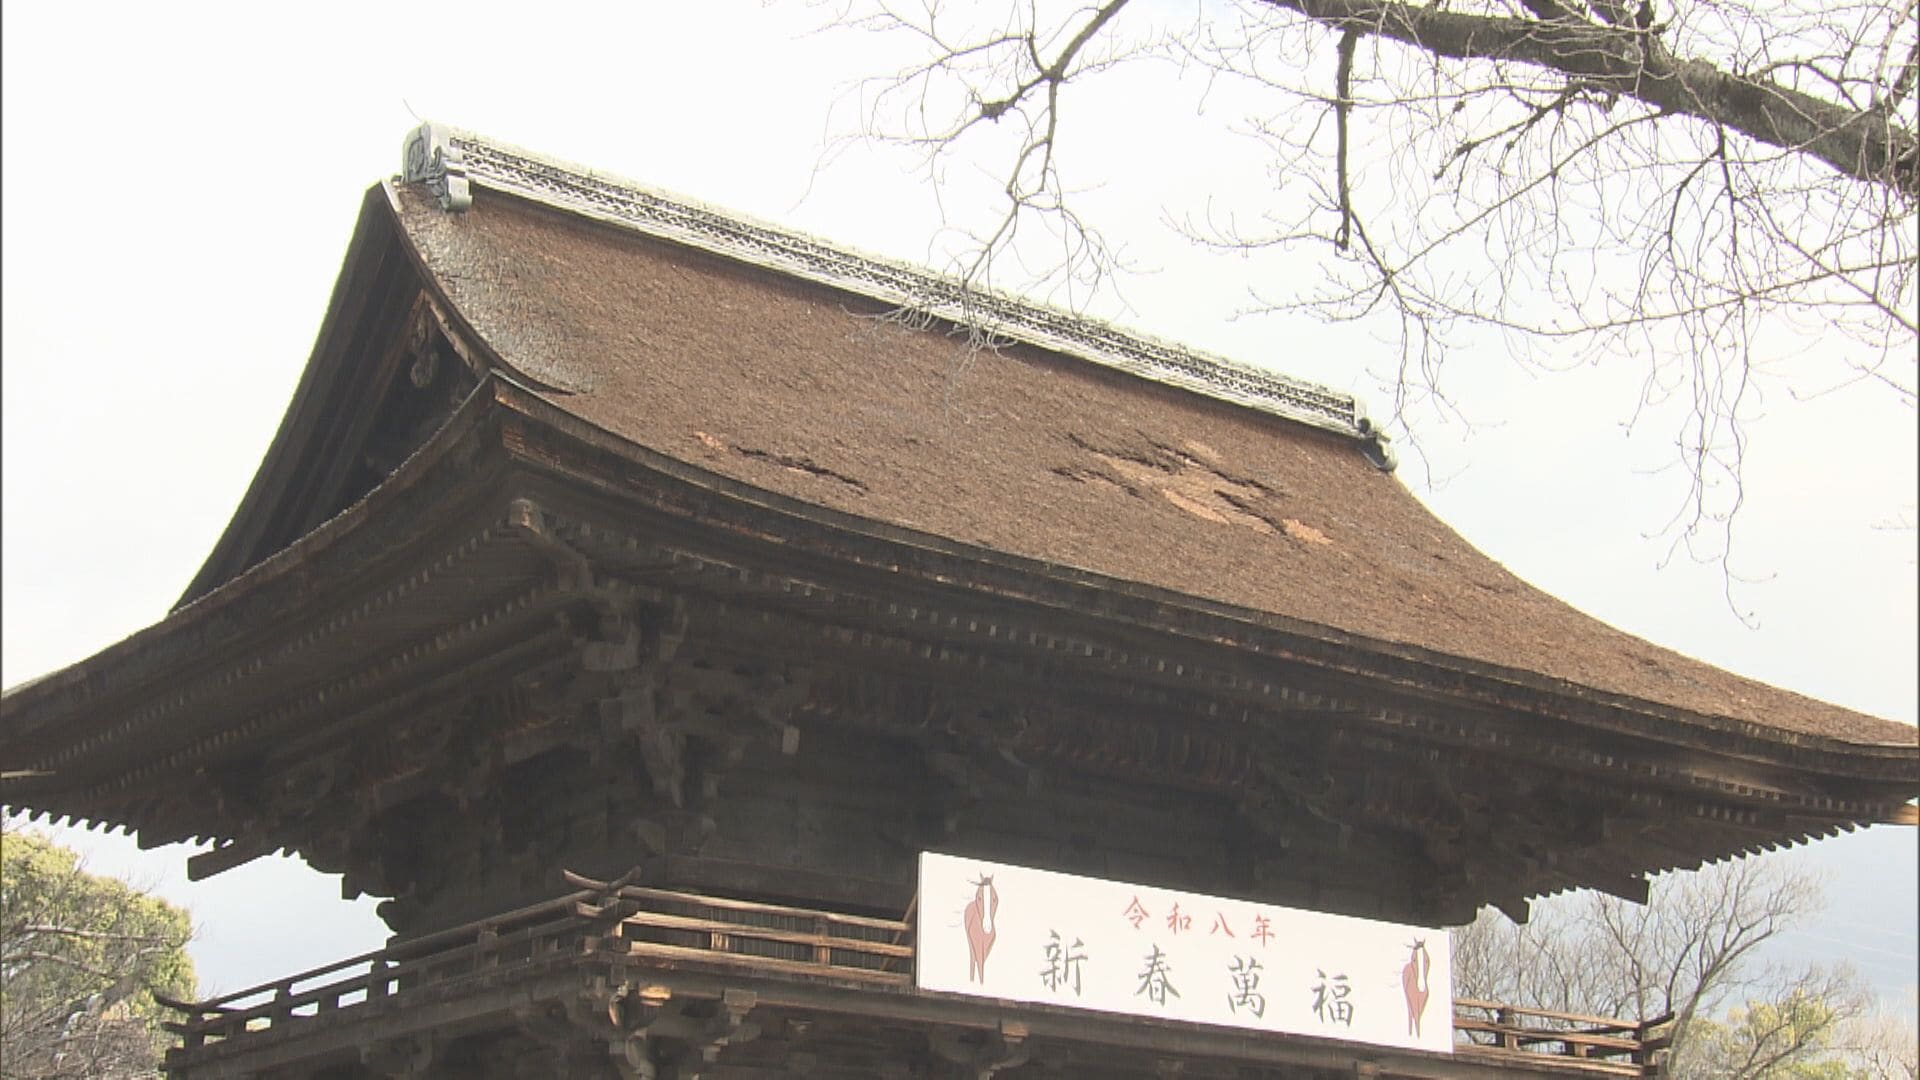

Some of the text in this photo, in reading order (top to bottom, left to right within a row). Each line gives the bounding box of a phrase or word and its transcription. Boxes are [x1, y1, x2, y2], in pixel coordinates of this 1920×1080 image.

[1122, 895, 1276, 947] 令和八年
[1038, 929, 1355, 1028] 新春萬福
